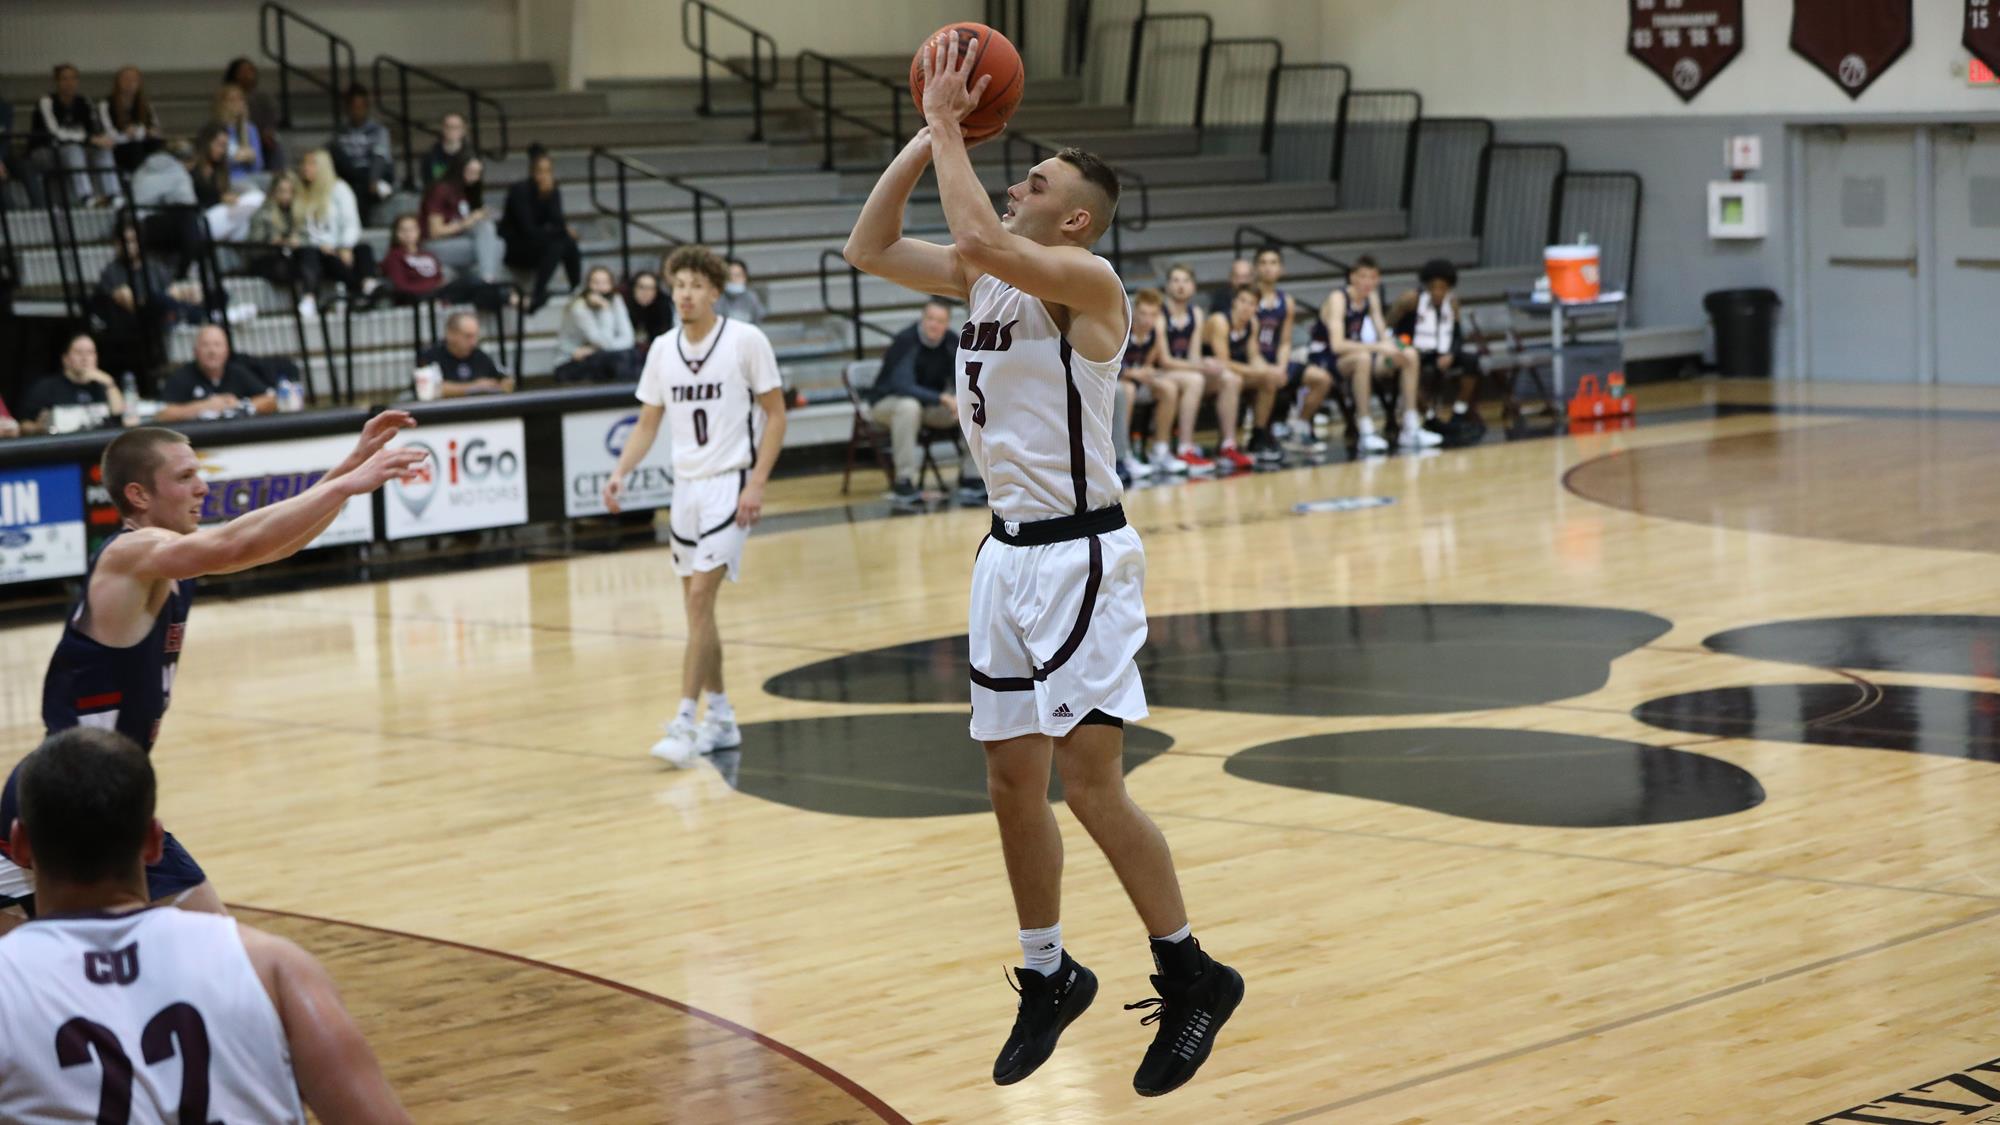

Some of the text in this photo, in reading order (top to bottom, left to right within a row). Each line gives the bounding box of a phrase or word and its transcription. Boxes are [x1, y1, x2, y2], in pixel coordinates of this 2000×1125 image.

[671, 382, 723, 403] TIGERS
[965, 361, 986, 428] 3
[693, 408, 708, 446] 0
[448, 438, 518, 486] iGo
[574, 466, 674, 497] CIZEN
[0, 479, 40, 528] IN
[1052, 710, 1074, 718] adidas
[85, 941, 140, 985] CU
[1178, 1011, 1212, 1061] ADVISORY
[55, 1001, 229, 1125] 22
